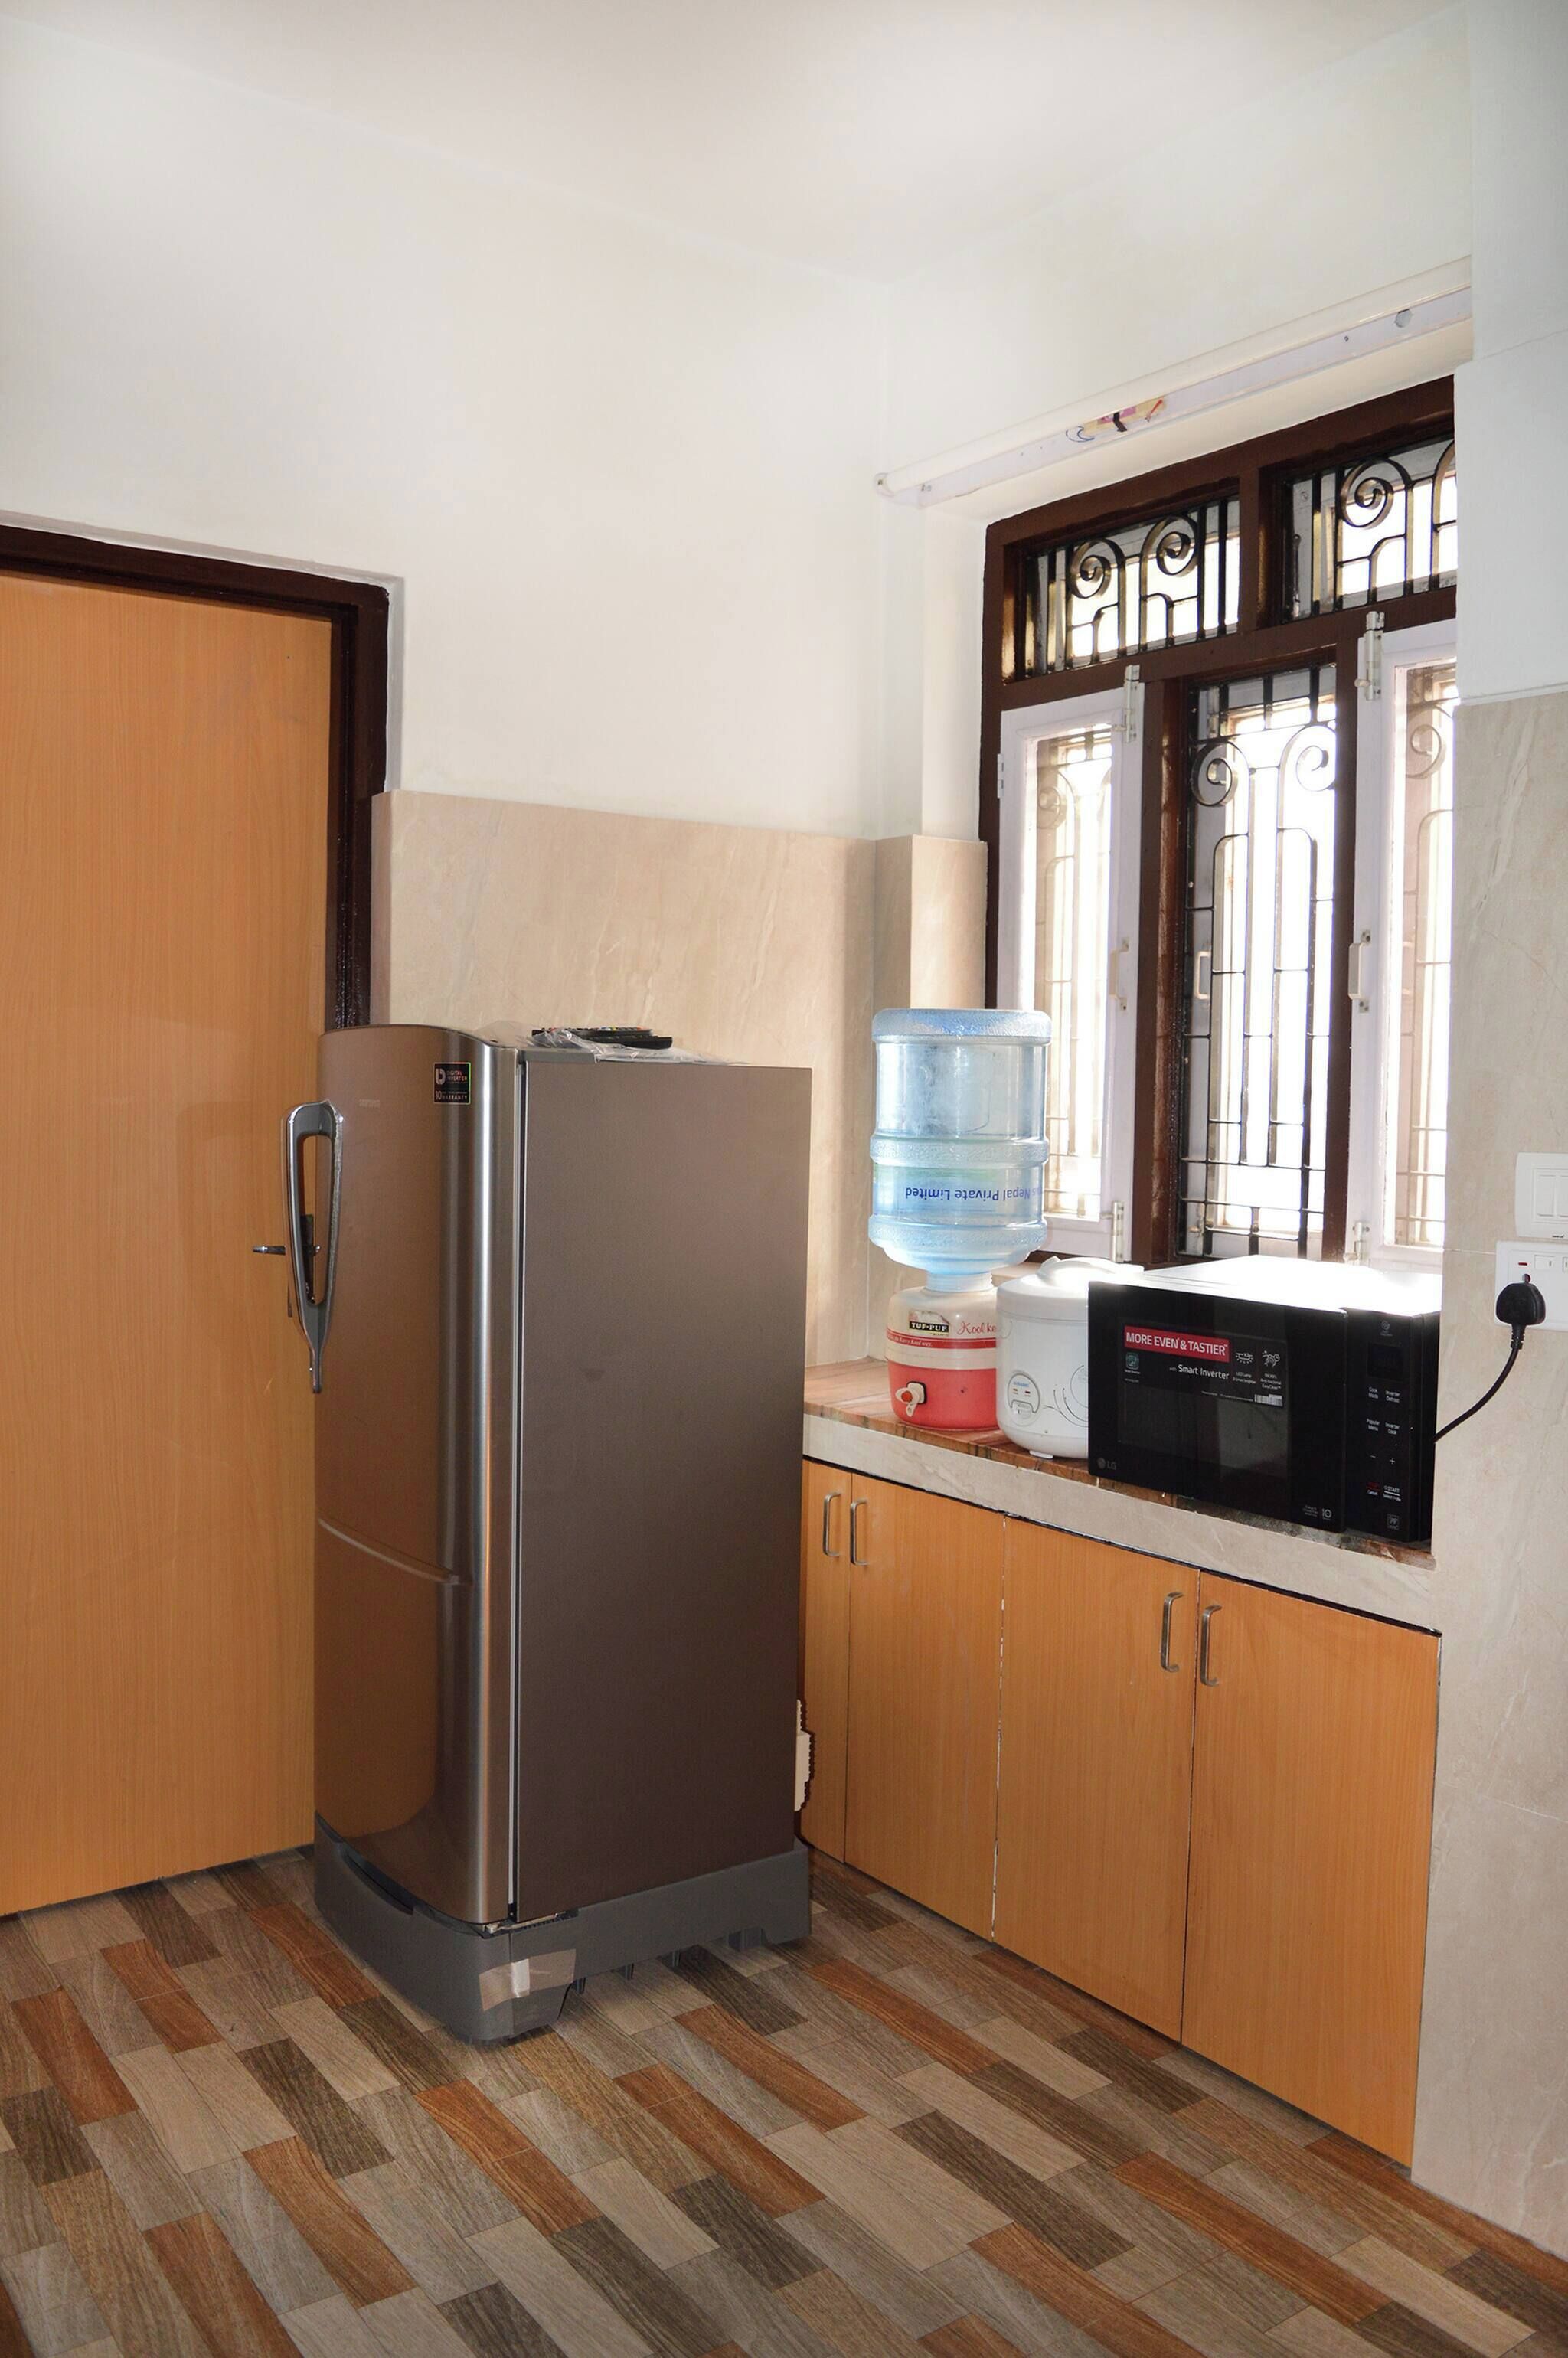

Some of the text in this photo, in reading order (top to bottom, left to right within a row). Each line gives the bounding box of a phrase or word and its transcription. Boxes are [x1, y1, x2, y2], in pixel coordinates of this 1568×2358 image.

[906, 1187, 950, 1201] Limited
[955, 1189, 999, 1201] Private
[1004, 1187, 1030, 1201] Nepal
[1126, 1332, 1152, 1345] MORE
[1155, 1336, 1178, 1349] EVEN
[1180, 1340, 1187, 1350] &
[1178, 1364, 1198, 1375] Smart
[1200, 1367, 1230, 1379] Inverter
